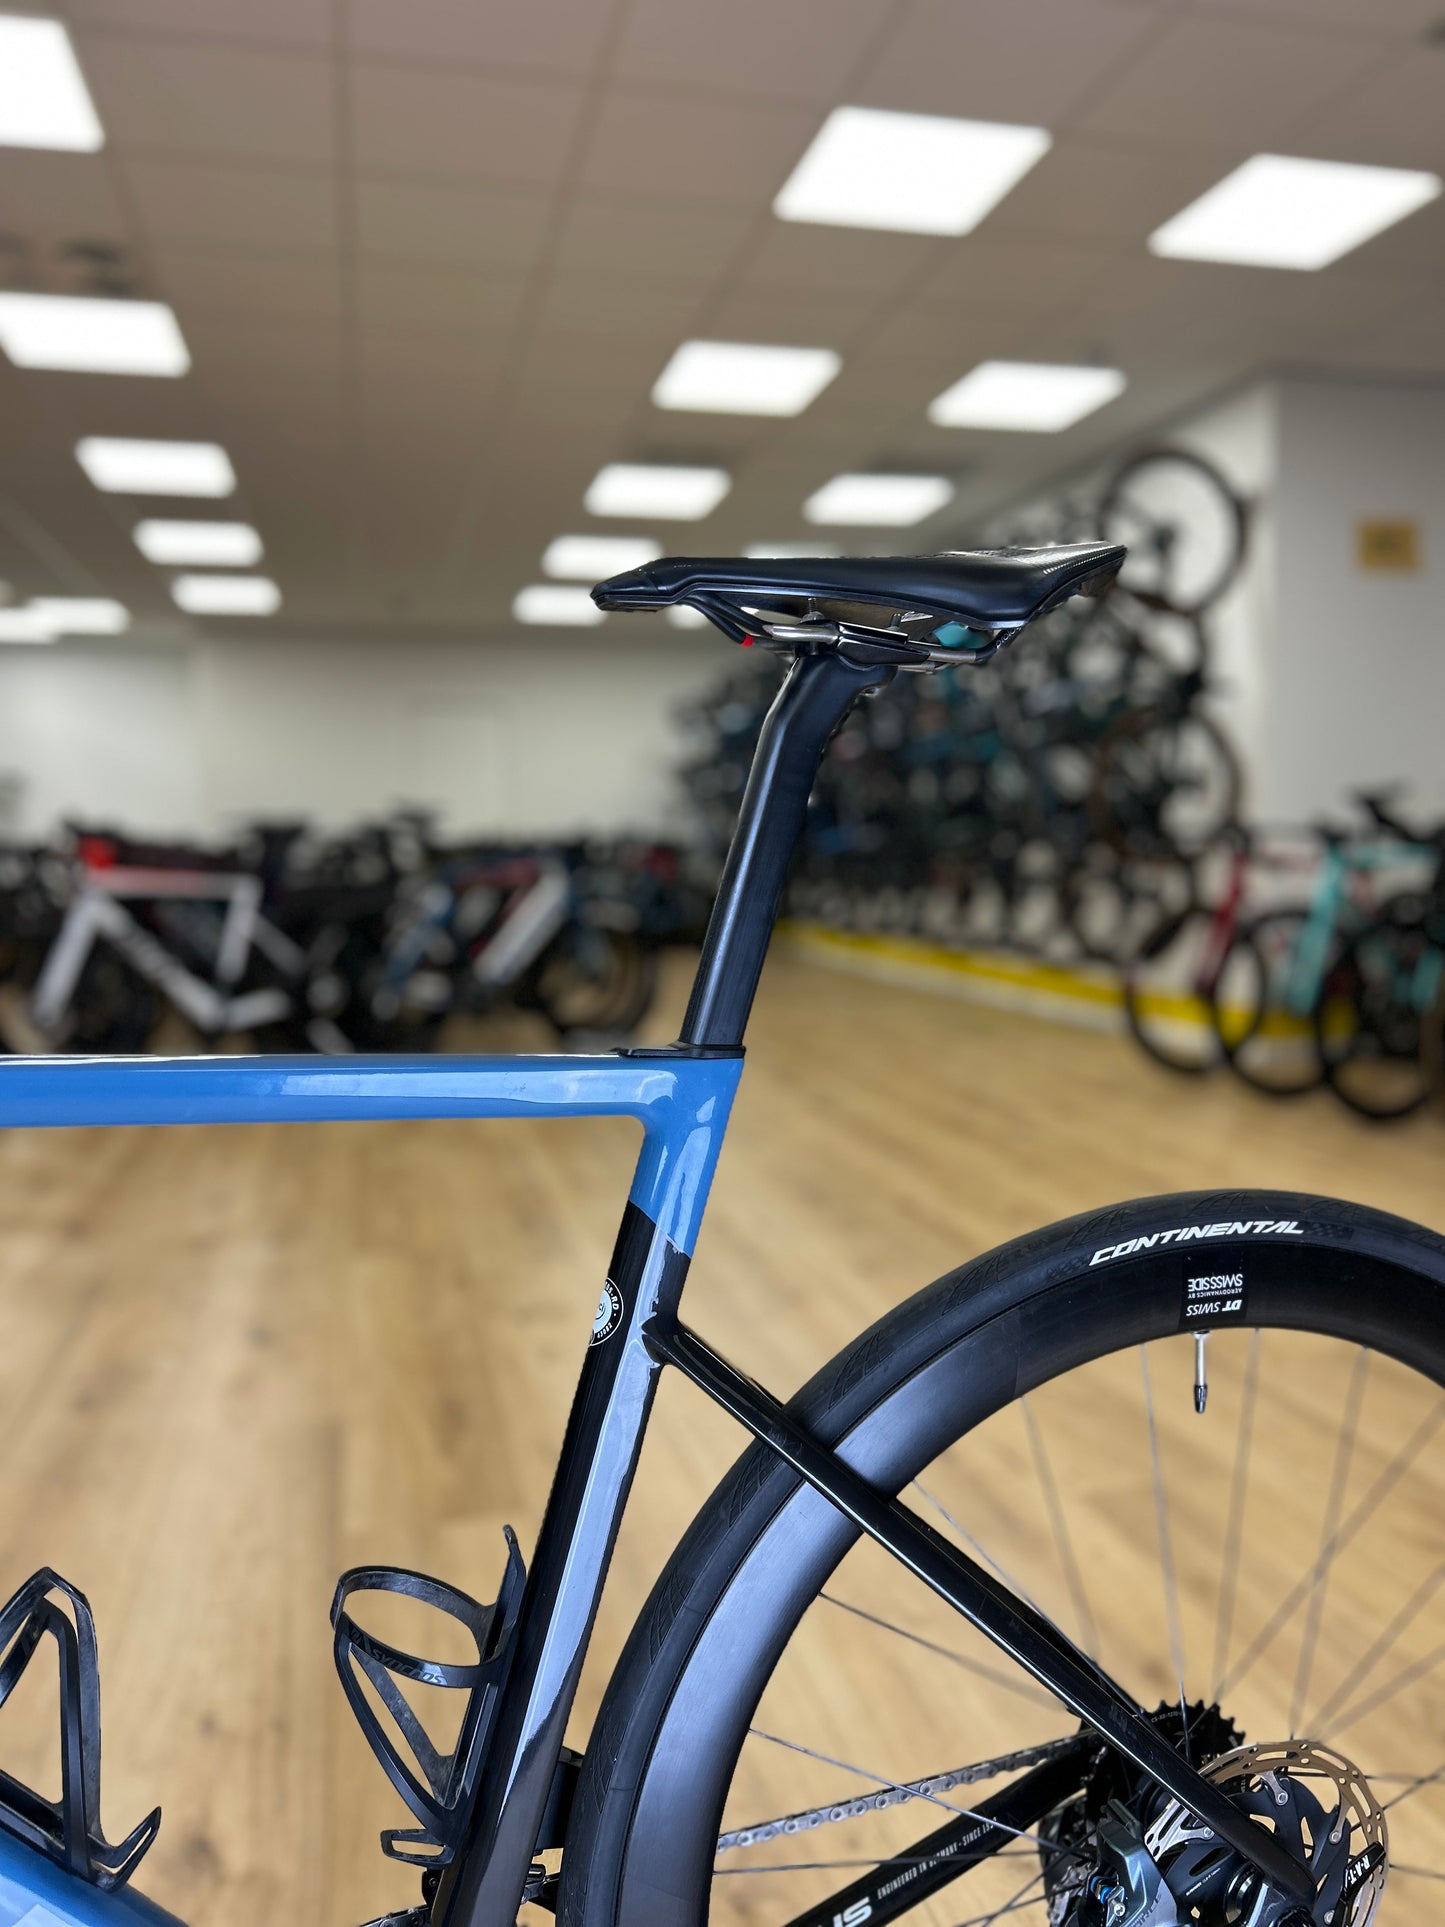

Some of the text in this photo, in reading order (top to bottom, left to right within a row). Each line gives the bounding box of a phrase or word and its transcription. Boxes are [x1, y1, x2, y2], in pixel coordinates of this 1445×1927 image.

[1088, 1220, 1304, 1267] CONTINENTAL
[1185, 1299, 1243, 1317] DT SWISS
[1197, 1287, 1243, 1298] AERODYNAMICS
[877, 1866, 918, 1900] ENGINEERED
[919, 1861, 928, 1874] IN
[962, 1826, 982, 1847] SINCE
